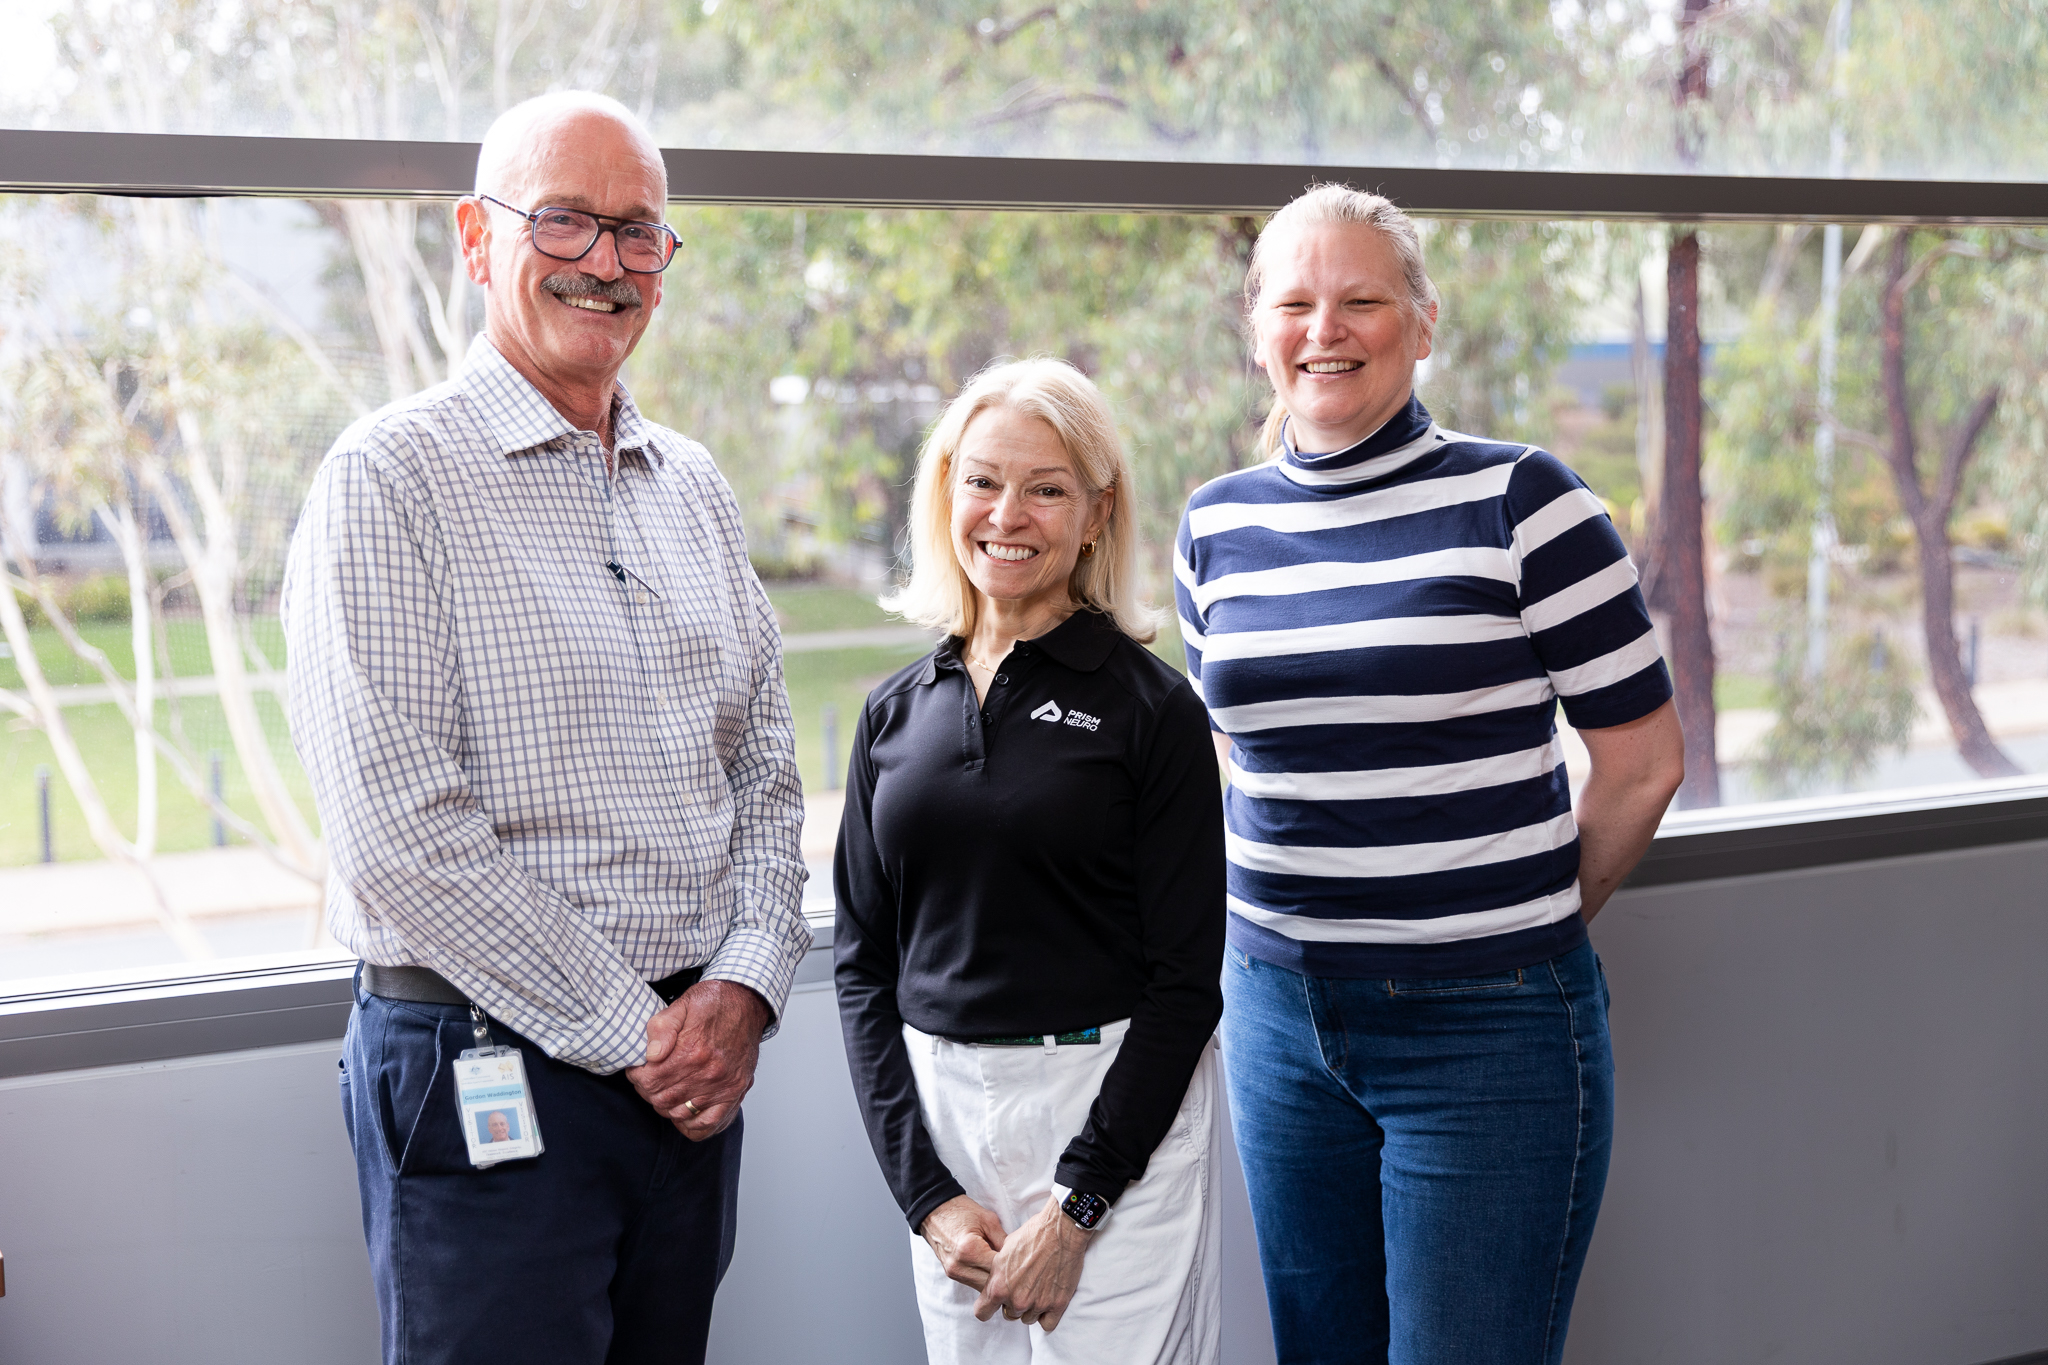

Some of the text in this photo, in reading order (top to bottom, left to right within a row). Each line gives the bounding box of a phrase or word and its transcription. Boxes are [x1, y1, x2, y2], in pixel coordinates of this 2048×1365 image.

[1063, 716, 1098, 732] NEURO
[1067, 709, 1101, 726] PRISM
[501, 1073, 515, 1081] AIS
[487, 1090, 521, 1098] Waddington
[466, 1108, 476, 1148] VISITOR
